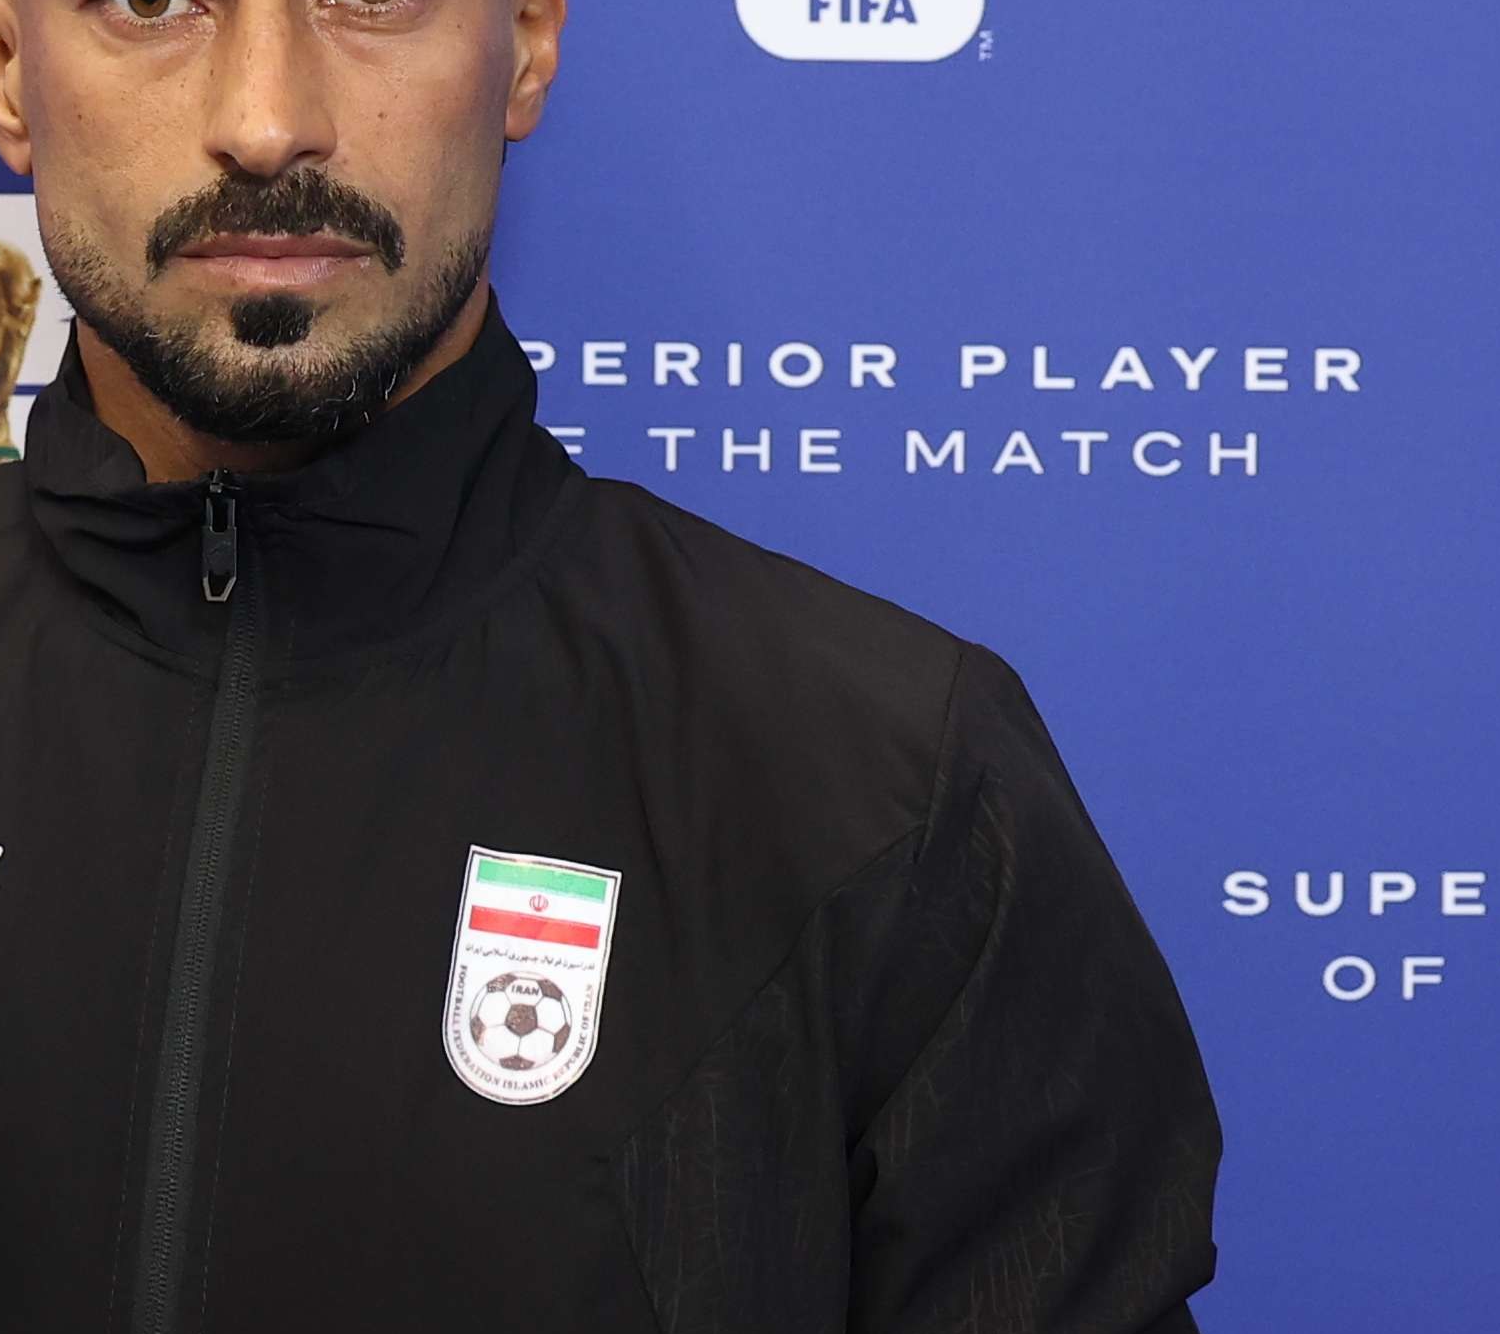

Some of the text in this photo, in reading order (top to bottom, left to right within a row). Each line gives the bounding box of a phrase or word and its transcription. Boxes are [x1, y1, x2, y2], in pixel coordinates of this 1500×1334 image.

[518, 340, 1361, 392] PERIOR PLAYER
[647, 427, 1257, 476] THE MATCH
[453, 964, 468, 1025] FOOTBALL
[511, 984, 540, 996] IRAN
[1322, 955, 1445, 1001] OF
